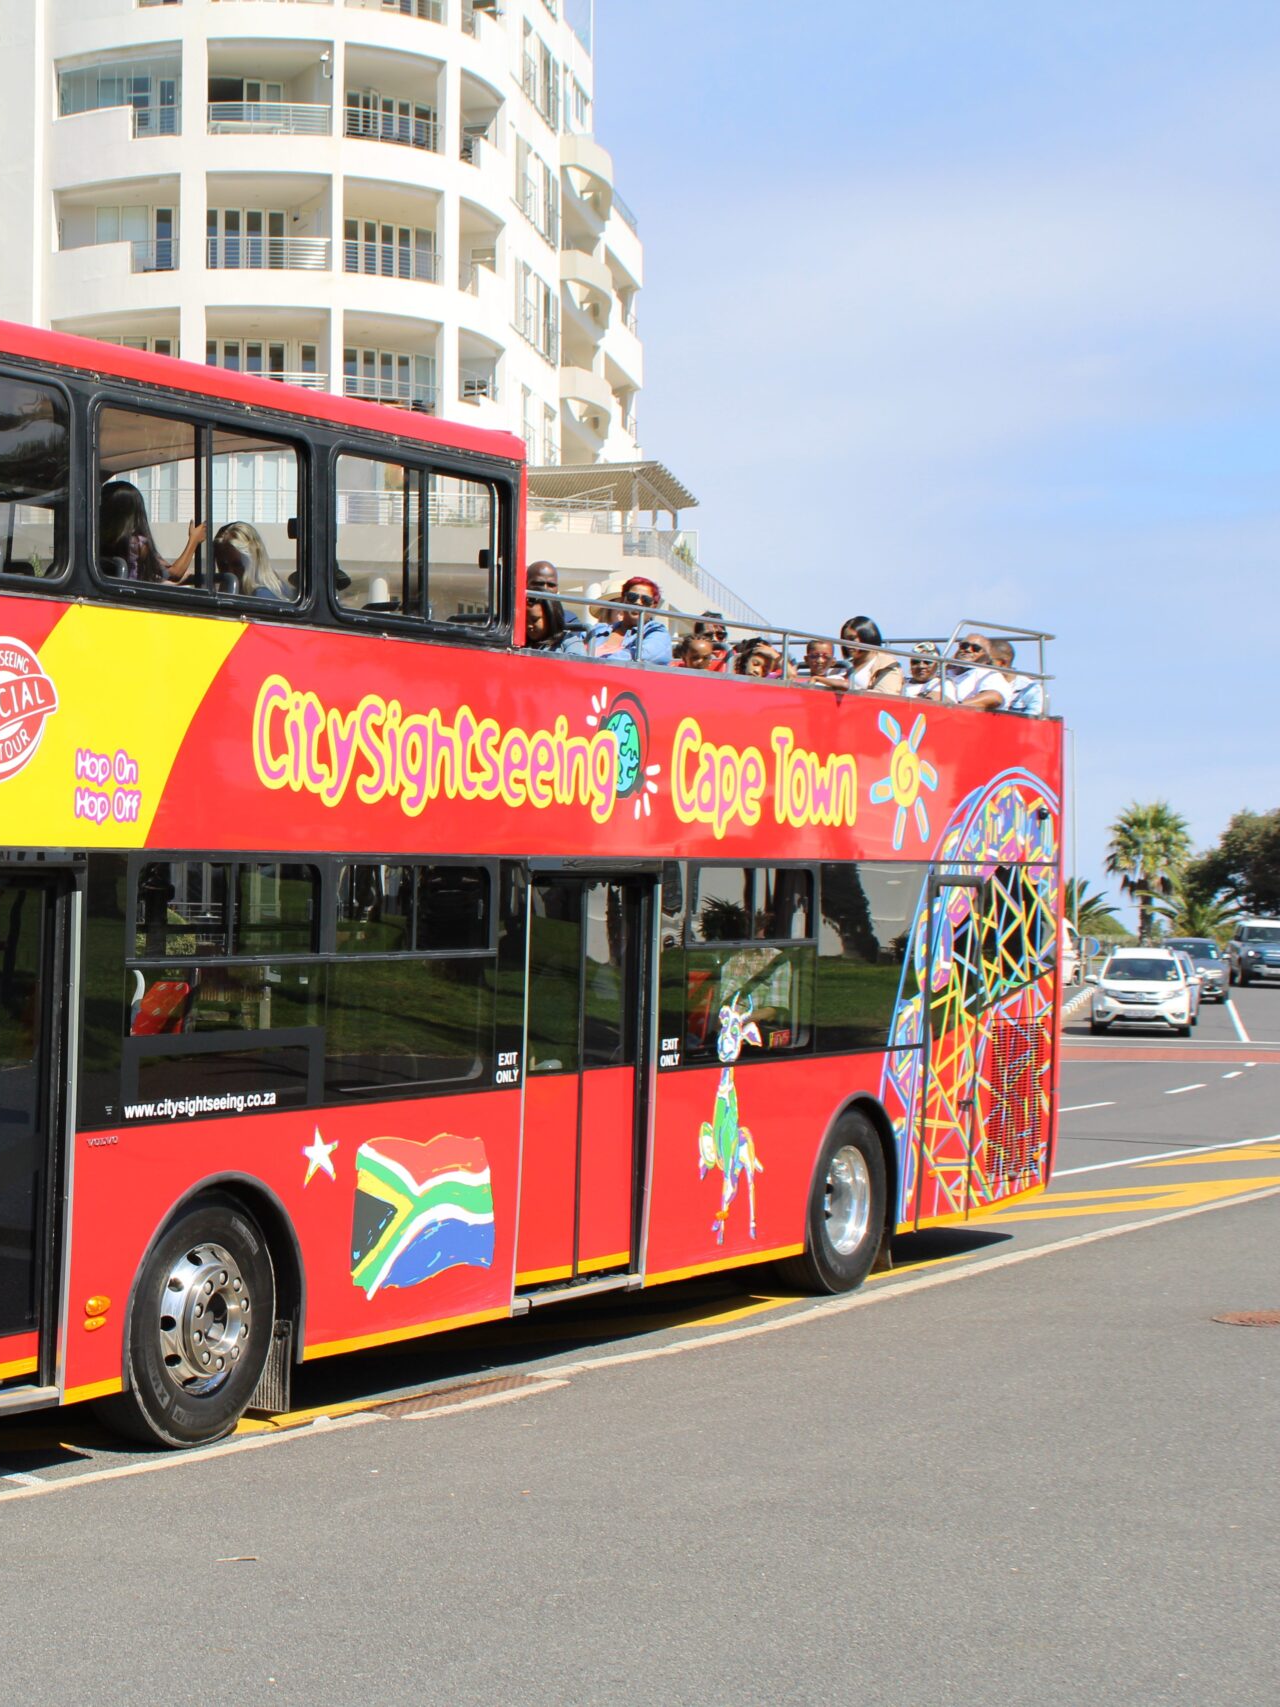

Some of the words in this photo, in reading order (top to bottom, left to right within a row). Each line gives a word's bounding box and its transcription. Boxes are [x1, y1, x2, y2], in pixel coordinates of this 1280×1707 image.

[253, 674, 617, 823] CitySightseeing
[672, 717, 766, 839] Cape
[772, 726, 857, 827] Town
[75, 748, 111, 787] Hop
[114, 749, 138, 784] On
[75, 786, 110, 825] Hop
[113, 787, 142, 823] Off
[662, 1037, 679, 1051] EXIT
[498, 1051, 518, 1067] EXIT
[660, 1053, 680, 1067] ONLY
[496, 1068, 519, 1084] ONLY
[124, 1092, 276, 1118] www.citysightseeing.co.za
